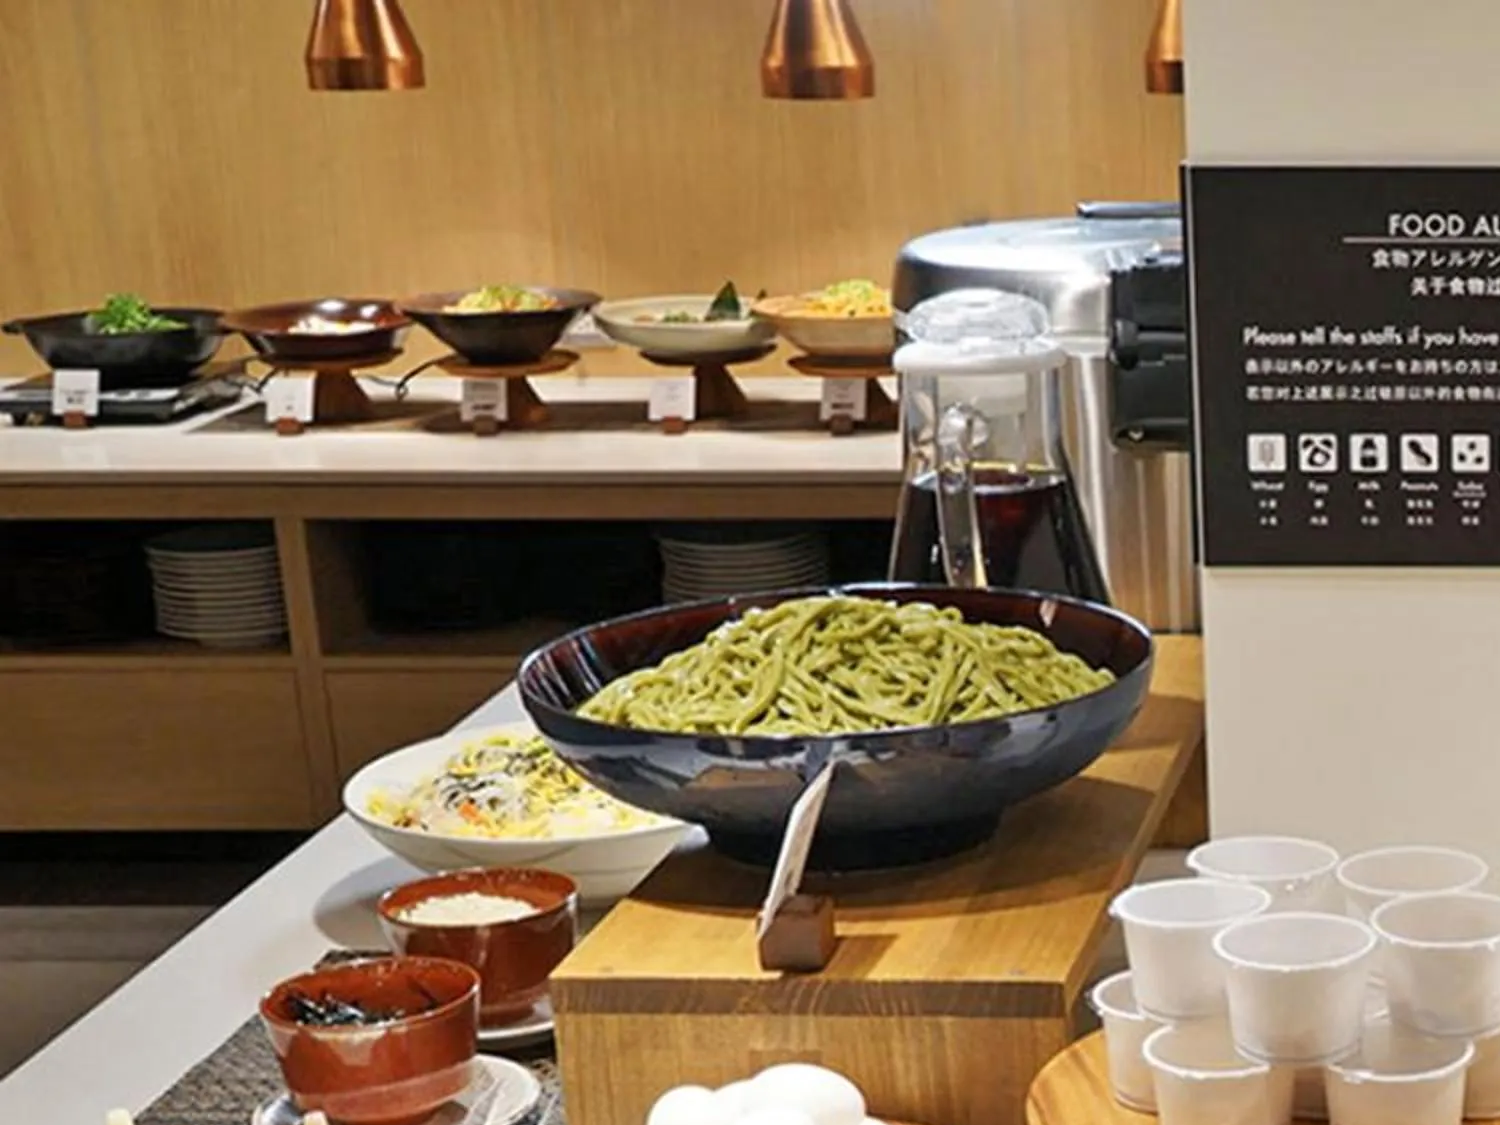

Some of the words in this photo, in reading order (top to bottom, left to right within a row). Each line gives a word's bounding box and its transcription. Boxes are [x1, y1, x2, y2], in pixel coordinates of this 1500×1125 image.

[1389, 214, 1465, 236] FOOD
[1243, 326, 1297, 345] Please
[1300, 325, 1325, 345] tell
[1329, 326, 1356, 345] the
[1360, 325, 1404, 345] staffs
[1406, 325, 1420, 345] if
[1423, 331, 1455, 350] you
[1458, 326, 1499, 346] have
